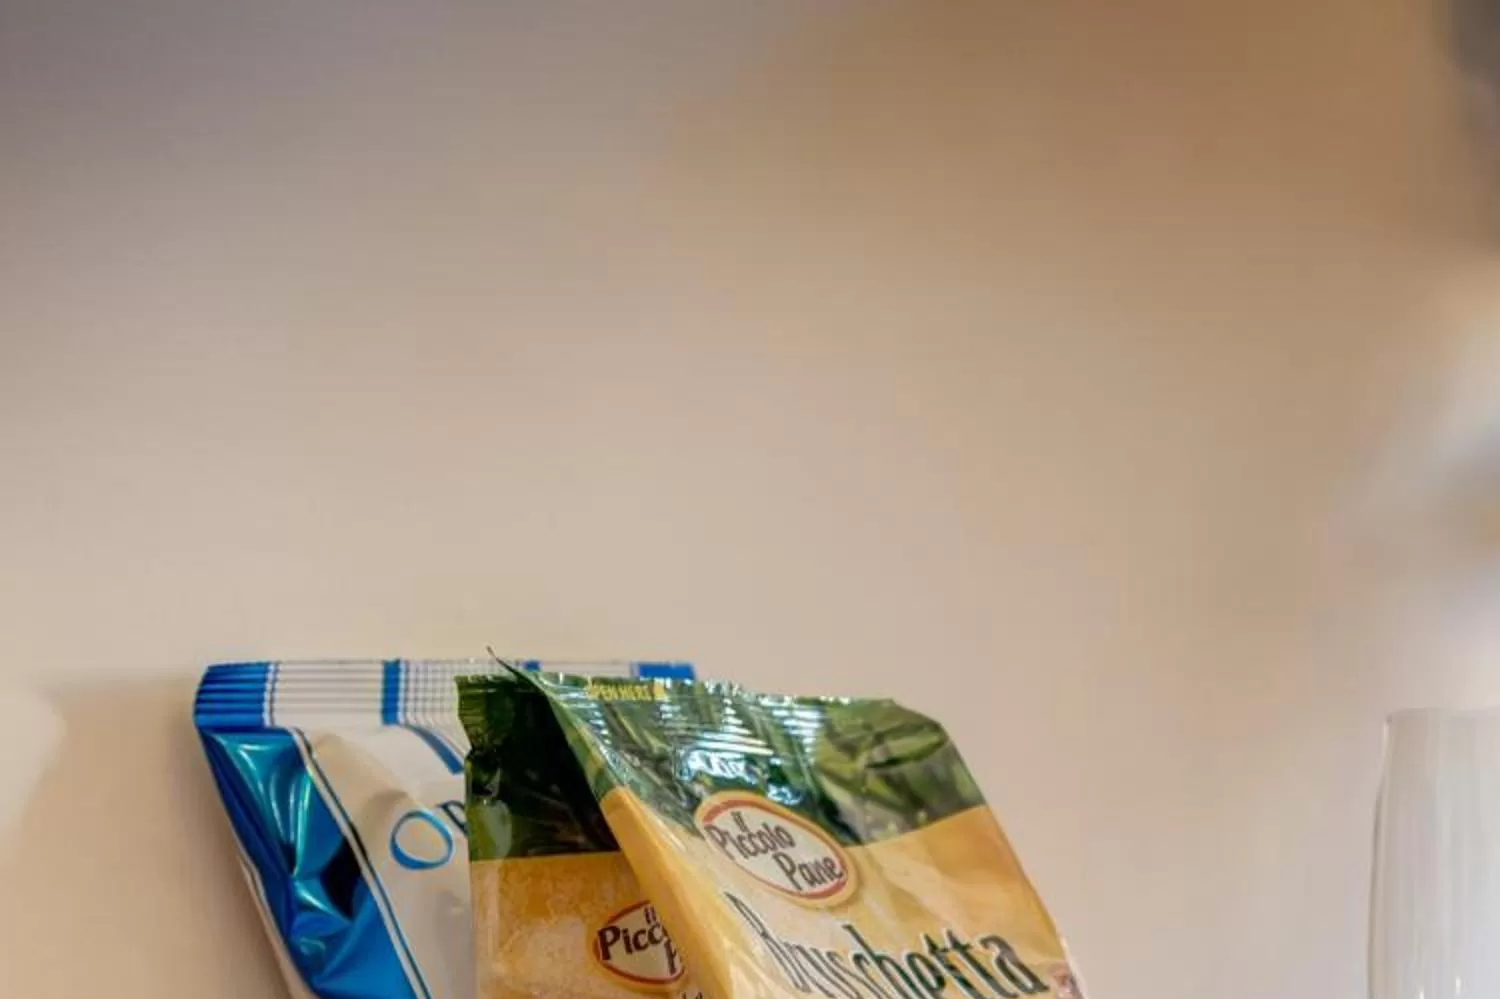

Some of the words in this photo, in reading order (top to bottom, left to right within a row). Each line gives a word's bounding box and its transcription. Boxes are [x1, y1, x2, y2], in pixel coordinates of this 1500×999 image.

[704, 822, 796, 862] Piccolo
[772, 851, 844, 891] Pane
[597, 922, 669, 961] Picc
